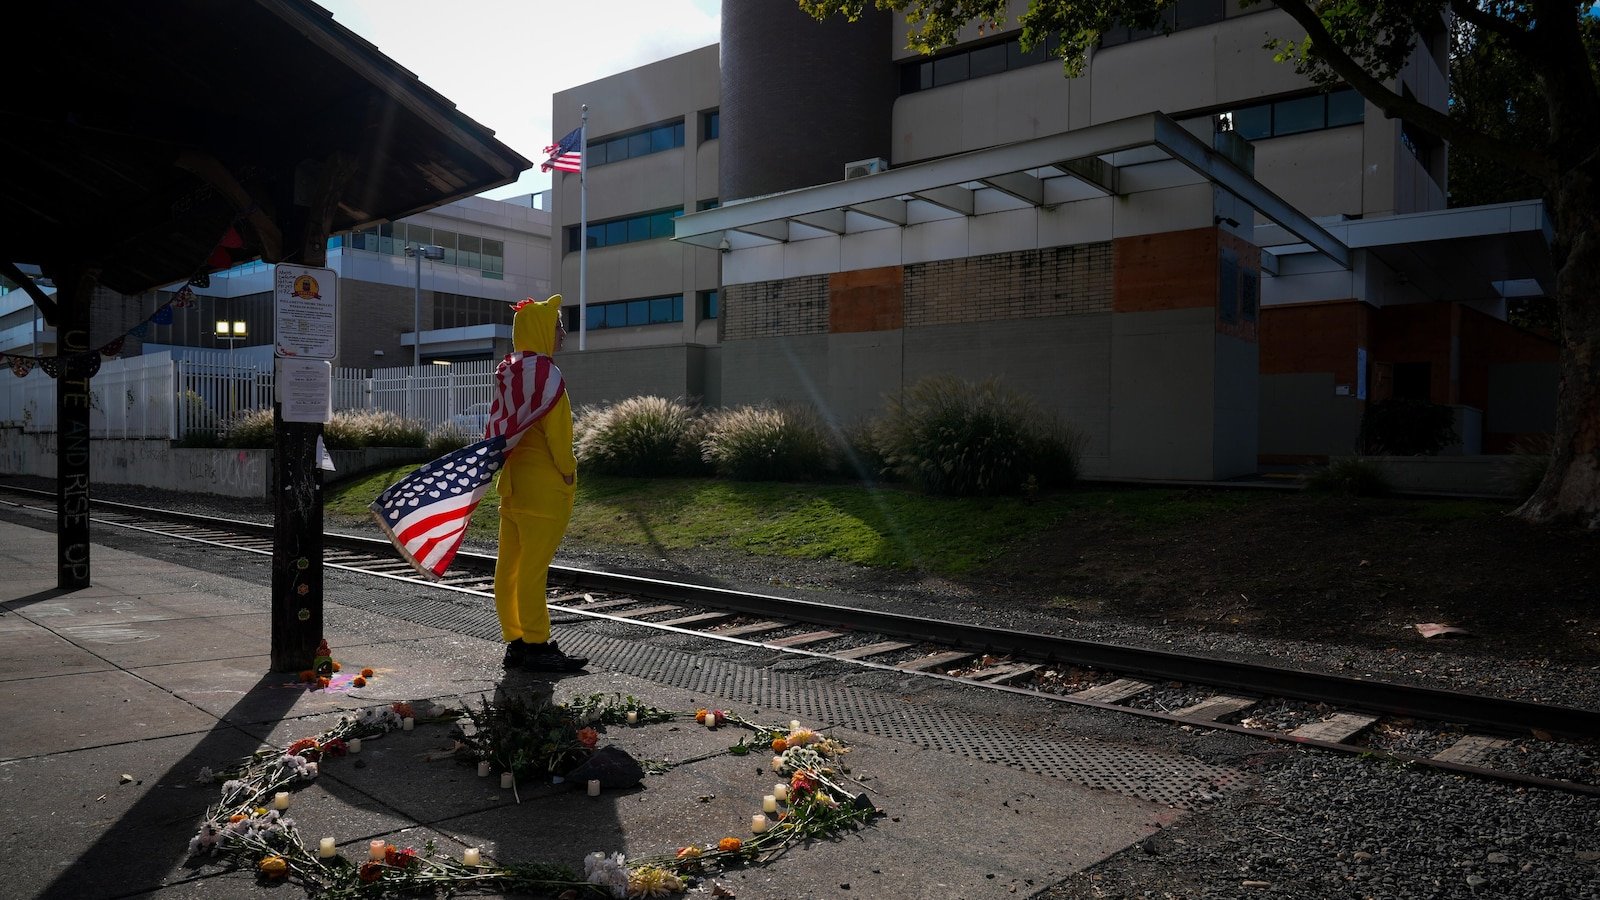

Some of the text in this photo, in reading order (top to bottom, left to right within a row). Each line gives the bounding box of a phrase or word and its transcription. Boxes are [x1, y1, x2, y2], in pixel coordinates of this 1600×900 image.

[64, 418, 88, 466] AND
[63, 473, 89, 529] RISE
[63, 542, 89, 580] UP
